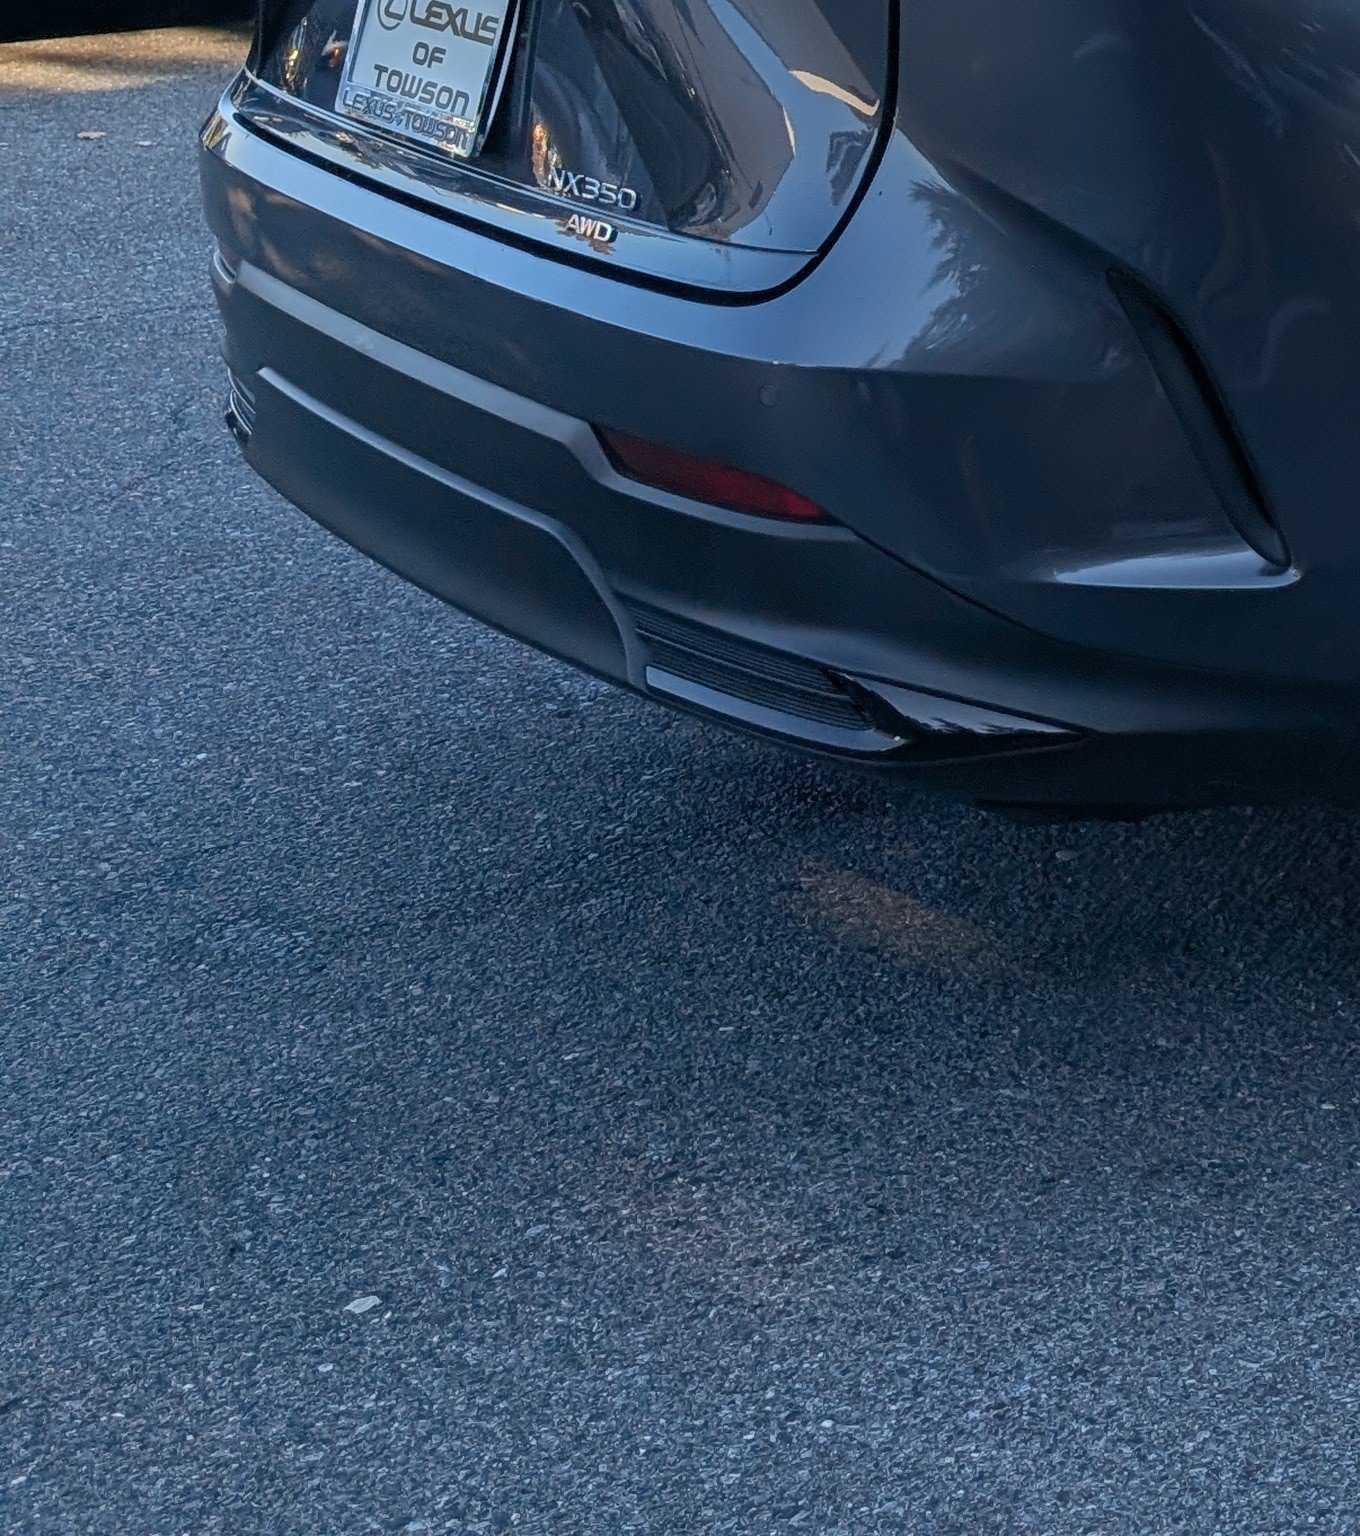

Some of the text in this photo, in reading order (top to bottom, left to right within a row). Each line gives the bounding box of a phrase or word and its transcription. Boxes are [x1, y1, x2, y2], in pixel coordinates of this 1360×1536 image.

[412, 41, 447, 69] OF
[373, 63, 470, 117] TOWSON
[342, 87, 397, 125] LEXUS
[401, 109, 470, 151] TOWSON
[547, 164, 637, 212] NX350
[563, 213, 616, 243] AWD
